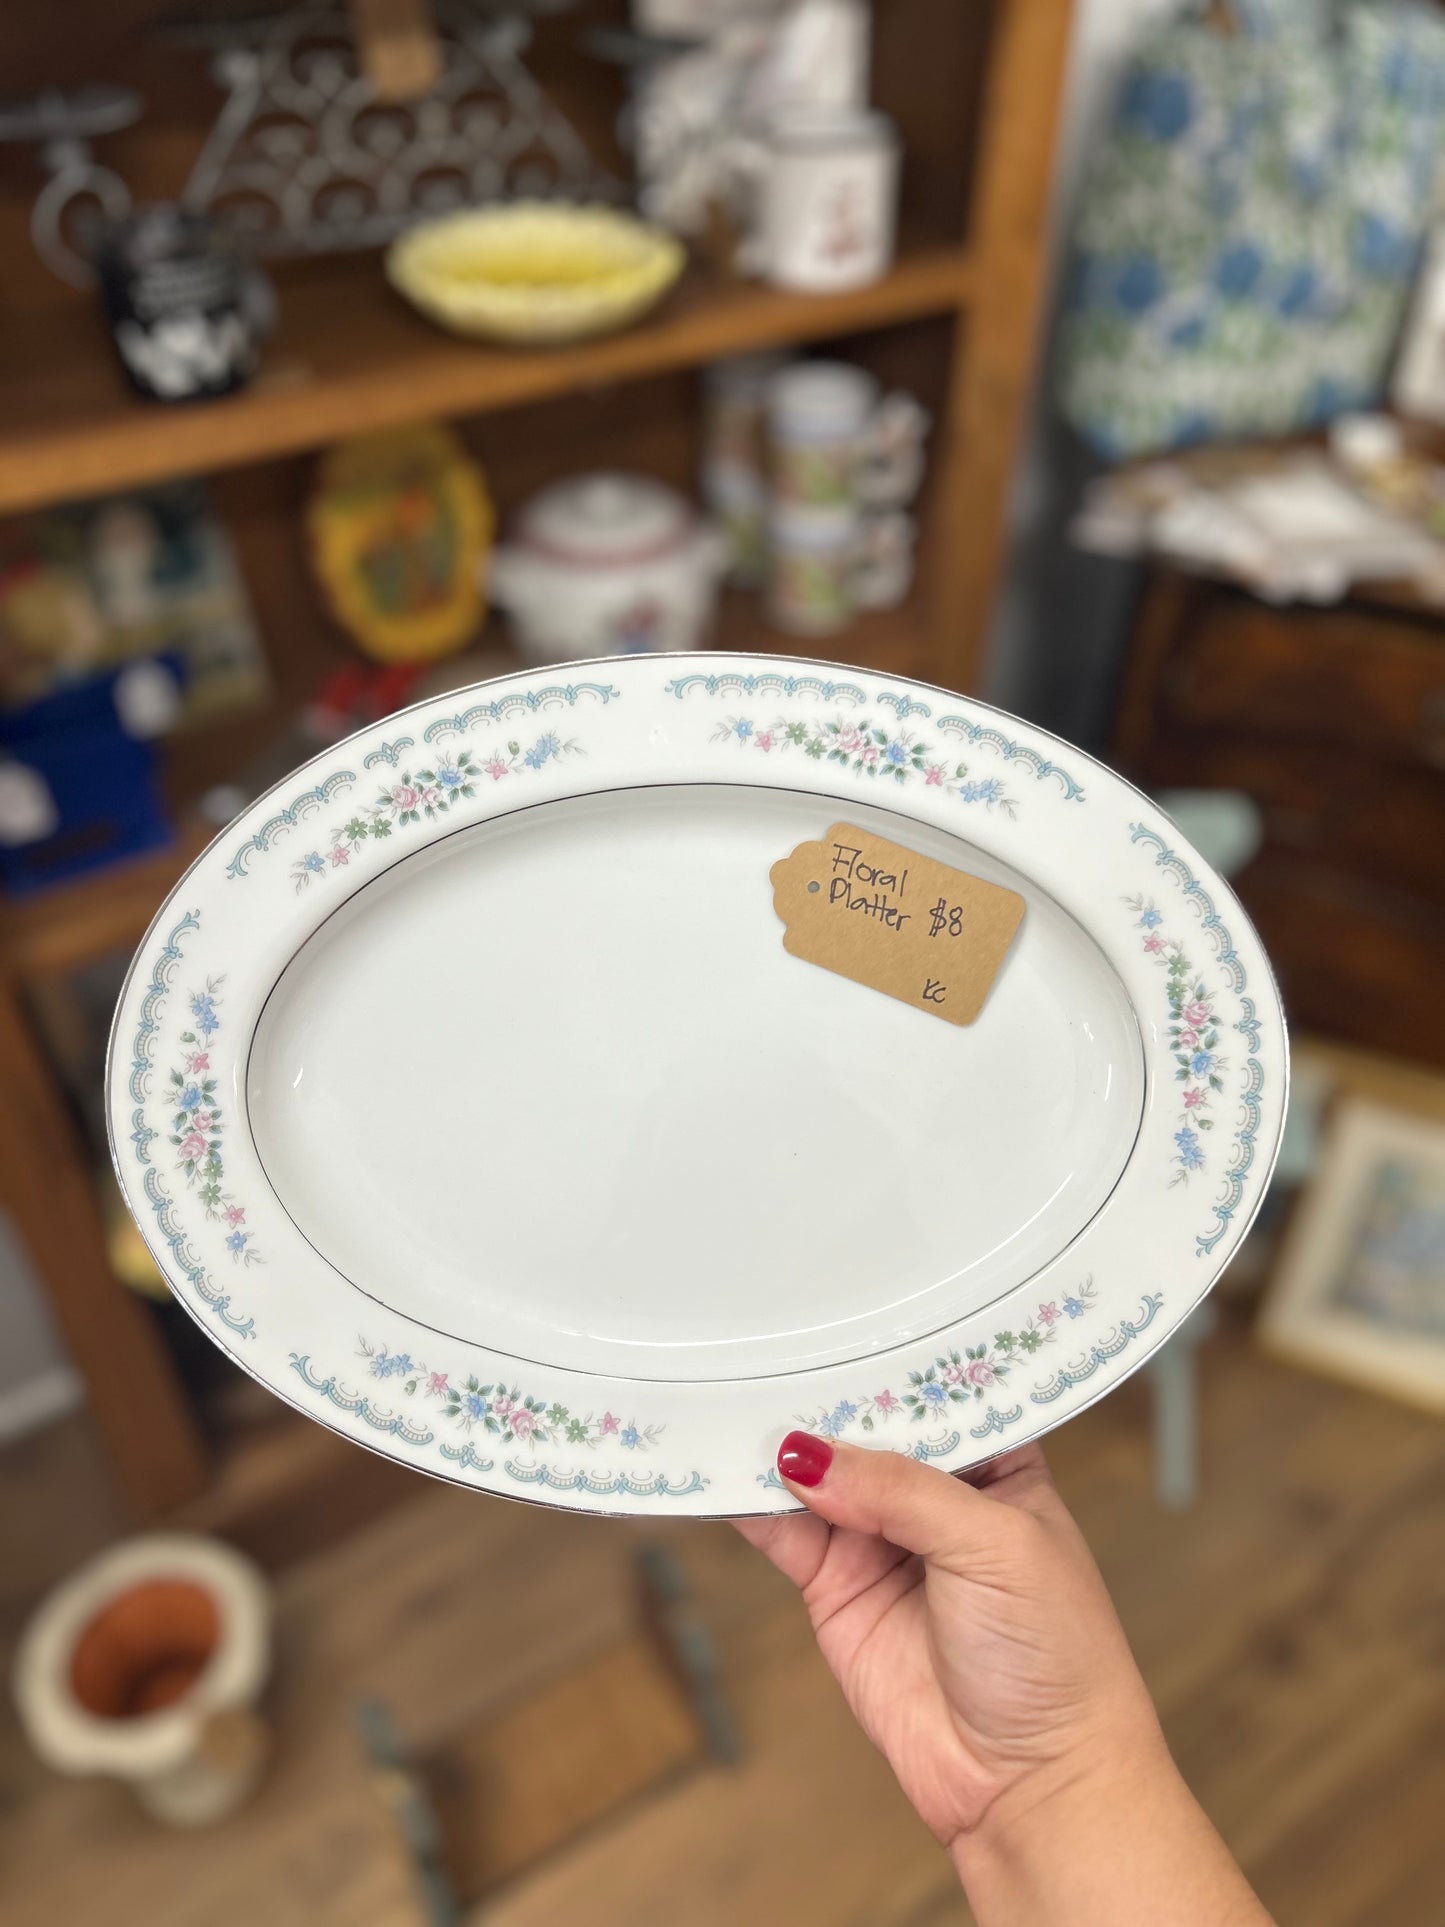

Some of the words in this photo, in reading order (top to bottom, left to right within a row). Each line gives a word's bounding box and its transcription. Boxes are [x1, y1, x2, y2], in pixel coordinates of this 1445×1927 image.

[833, 843, 908, 897] Floral
[830, 878, 911, 931] Platter
[929, 897, 963, 937] $8
